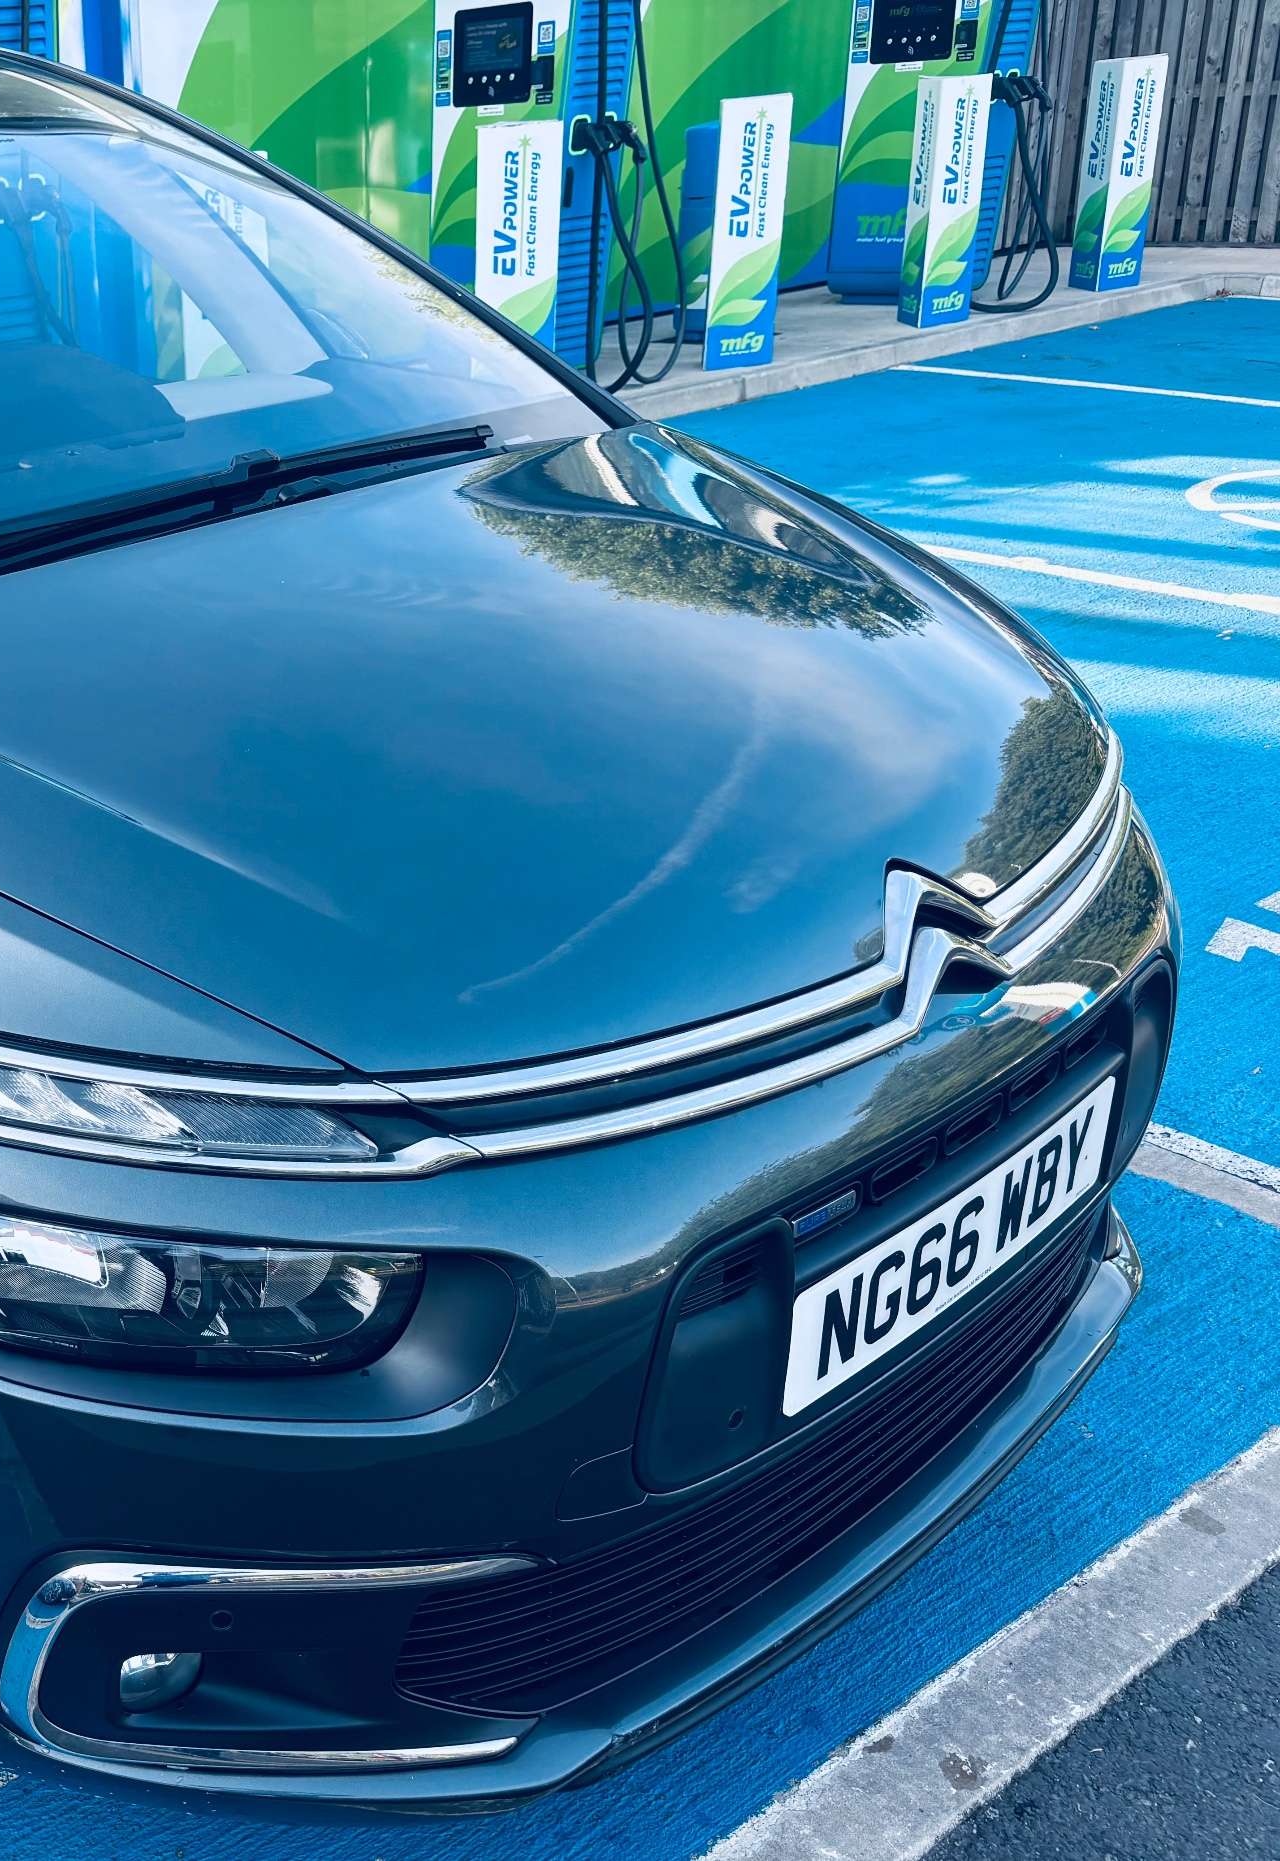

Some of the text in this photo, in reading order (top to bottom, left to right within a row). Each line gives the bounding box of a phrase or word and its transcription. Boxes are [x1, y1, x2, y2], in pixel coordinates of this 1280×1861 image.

[942, 97, 967, 205] EV POWER
[961, 99, 979, 204] Fast Clean Energy
[1087, 79, 1107, 178] EV POWER
[1120, 77, 1146, 177] EV POWER
[1136, 79, 1157, 178] Fast Clean Energy
[492, 150, 519, 277] EV POWER
[525, 152, 541, 277] Fast Clean Energy
[728, 121, 757, 238] EV POWER
[755, 123, 775, 238] Fast Clean Energy
[857, 207, 906, 237] mf
[932, 290, 965, 311] mfg
[1108, 257, 1138, 276] mfg
[720, 331, 765, 353] mfg
[816, 1105, 1095, 1381] NG66 WBY
